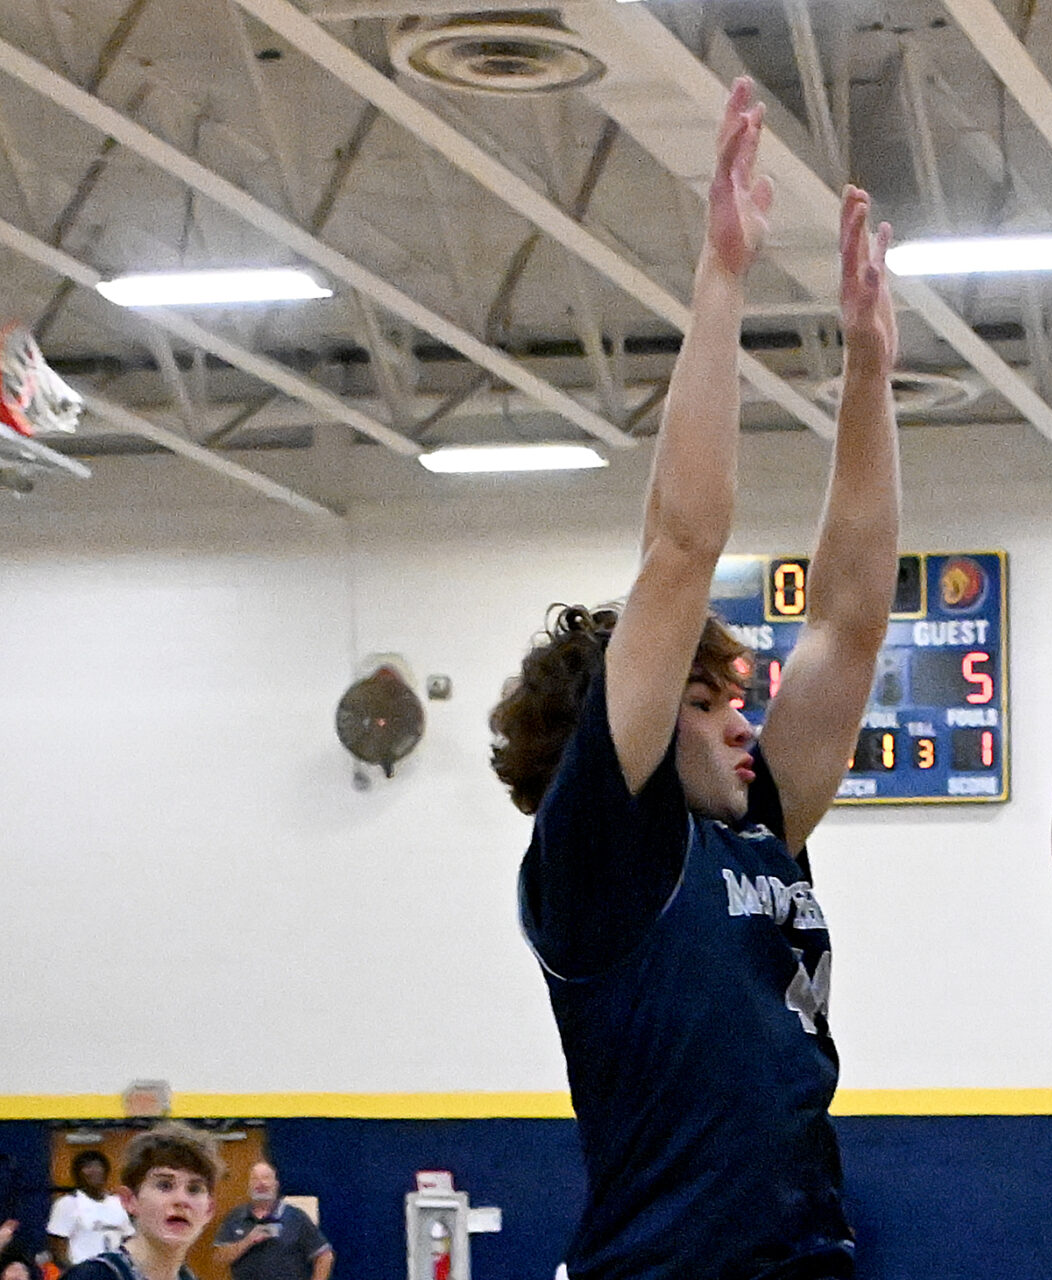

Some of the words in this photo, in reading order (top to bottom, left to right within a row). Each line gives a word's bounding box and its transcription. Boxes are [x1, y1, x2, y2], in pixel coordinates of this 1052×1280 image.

[913, 619, 990, 646] GUEST
[961, 651, 994, 704] 5
[918, 739, 935, 769] 3
[981, 731, 994, 767] 1
